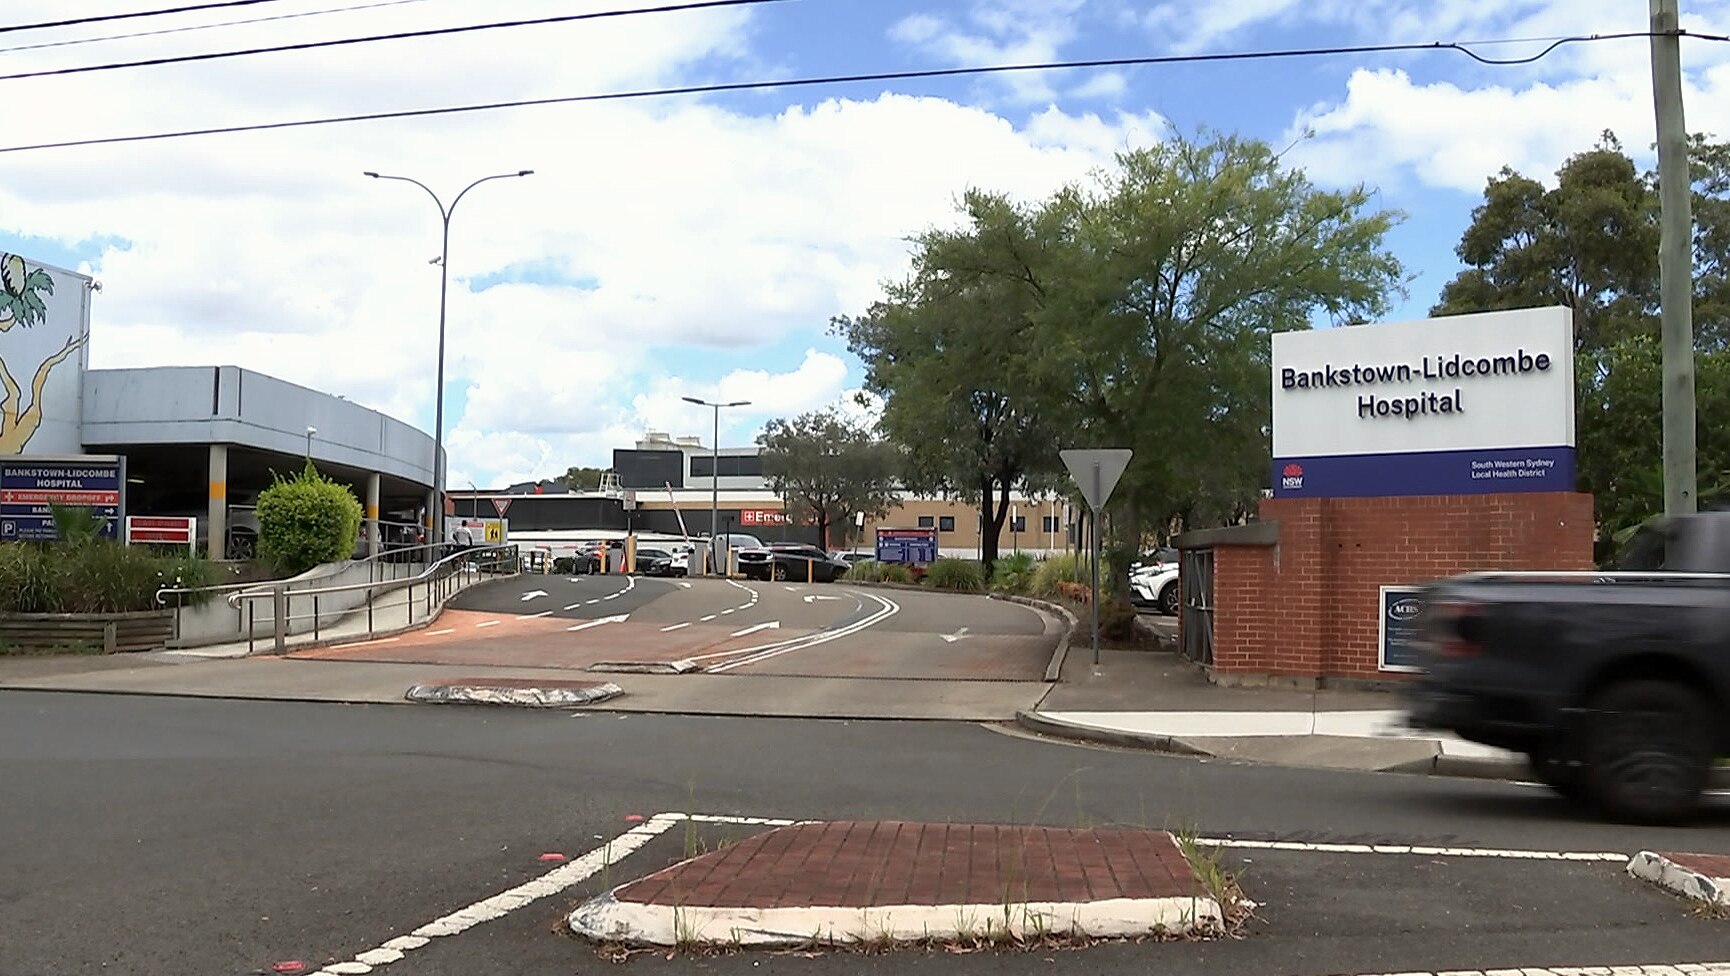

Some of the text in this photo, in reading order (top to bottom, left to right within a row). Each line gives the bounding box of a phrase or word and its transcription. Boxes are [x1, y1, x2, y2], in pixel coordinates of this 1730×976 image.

[1281, 349, 1551, 389] Bankstown-Lidcombe
[1357, 389, 1463, 418] Hospital
[1471, 459, 1555, 469] South Western Sydney
[4, 469, 116, 478] BANKSTOWN-LIDCOMBE
[1471, 469, 1546, 478] Local Health District
[36, 479, 83, 488] HOSPITAL
[1282, 477, 1303, 486] NSW
